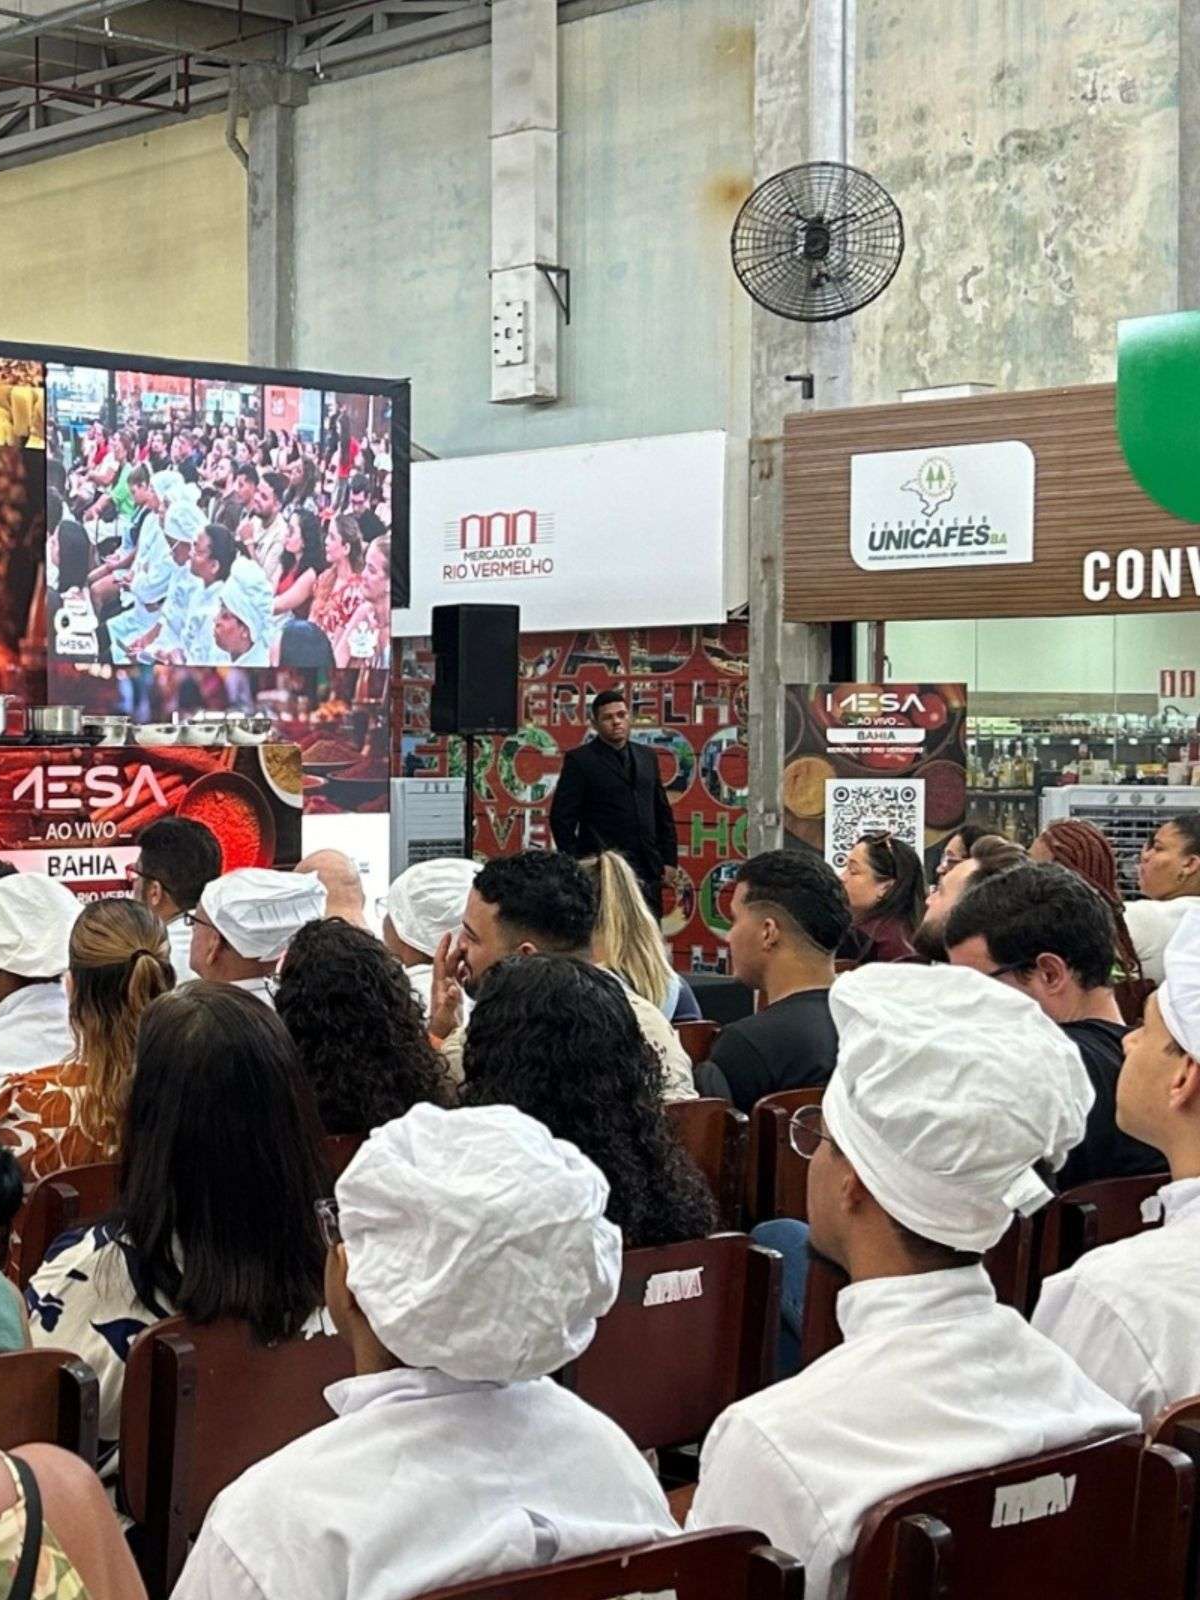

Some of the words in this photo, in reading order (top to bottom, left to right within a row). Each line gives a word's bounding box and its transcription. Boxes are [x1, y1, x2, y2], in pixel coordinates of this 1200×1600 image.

[868, 525, 990, 551] UNICAFES
[464, 549, 515, 561] MERCADO
[516, 548, 532, 558] DO
[443, 564, 468, 580] RIO
[471, 558, 554, 577] VERMELHO
[826, 693, 926, 712] MESA
[857, 717, 871, 726] AO
[873, 717, 896, 726] VIVO
[857, 731, 896, 740] BAHIA
[45, 823, 71, 840] AO
[75, 821, 116, 839] VIVO
[48, 855, 117, 877] BAHIA
